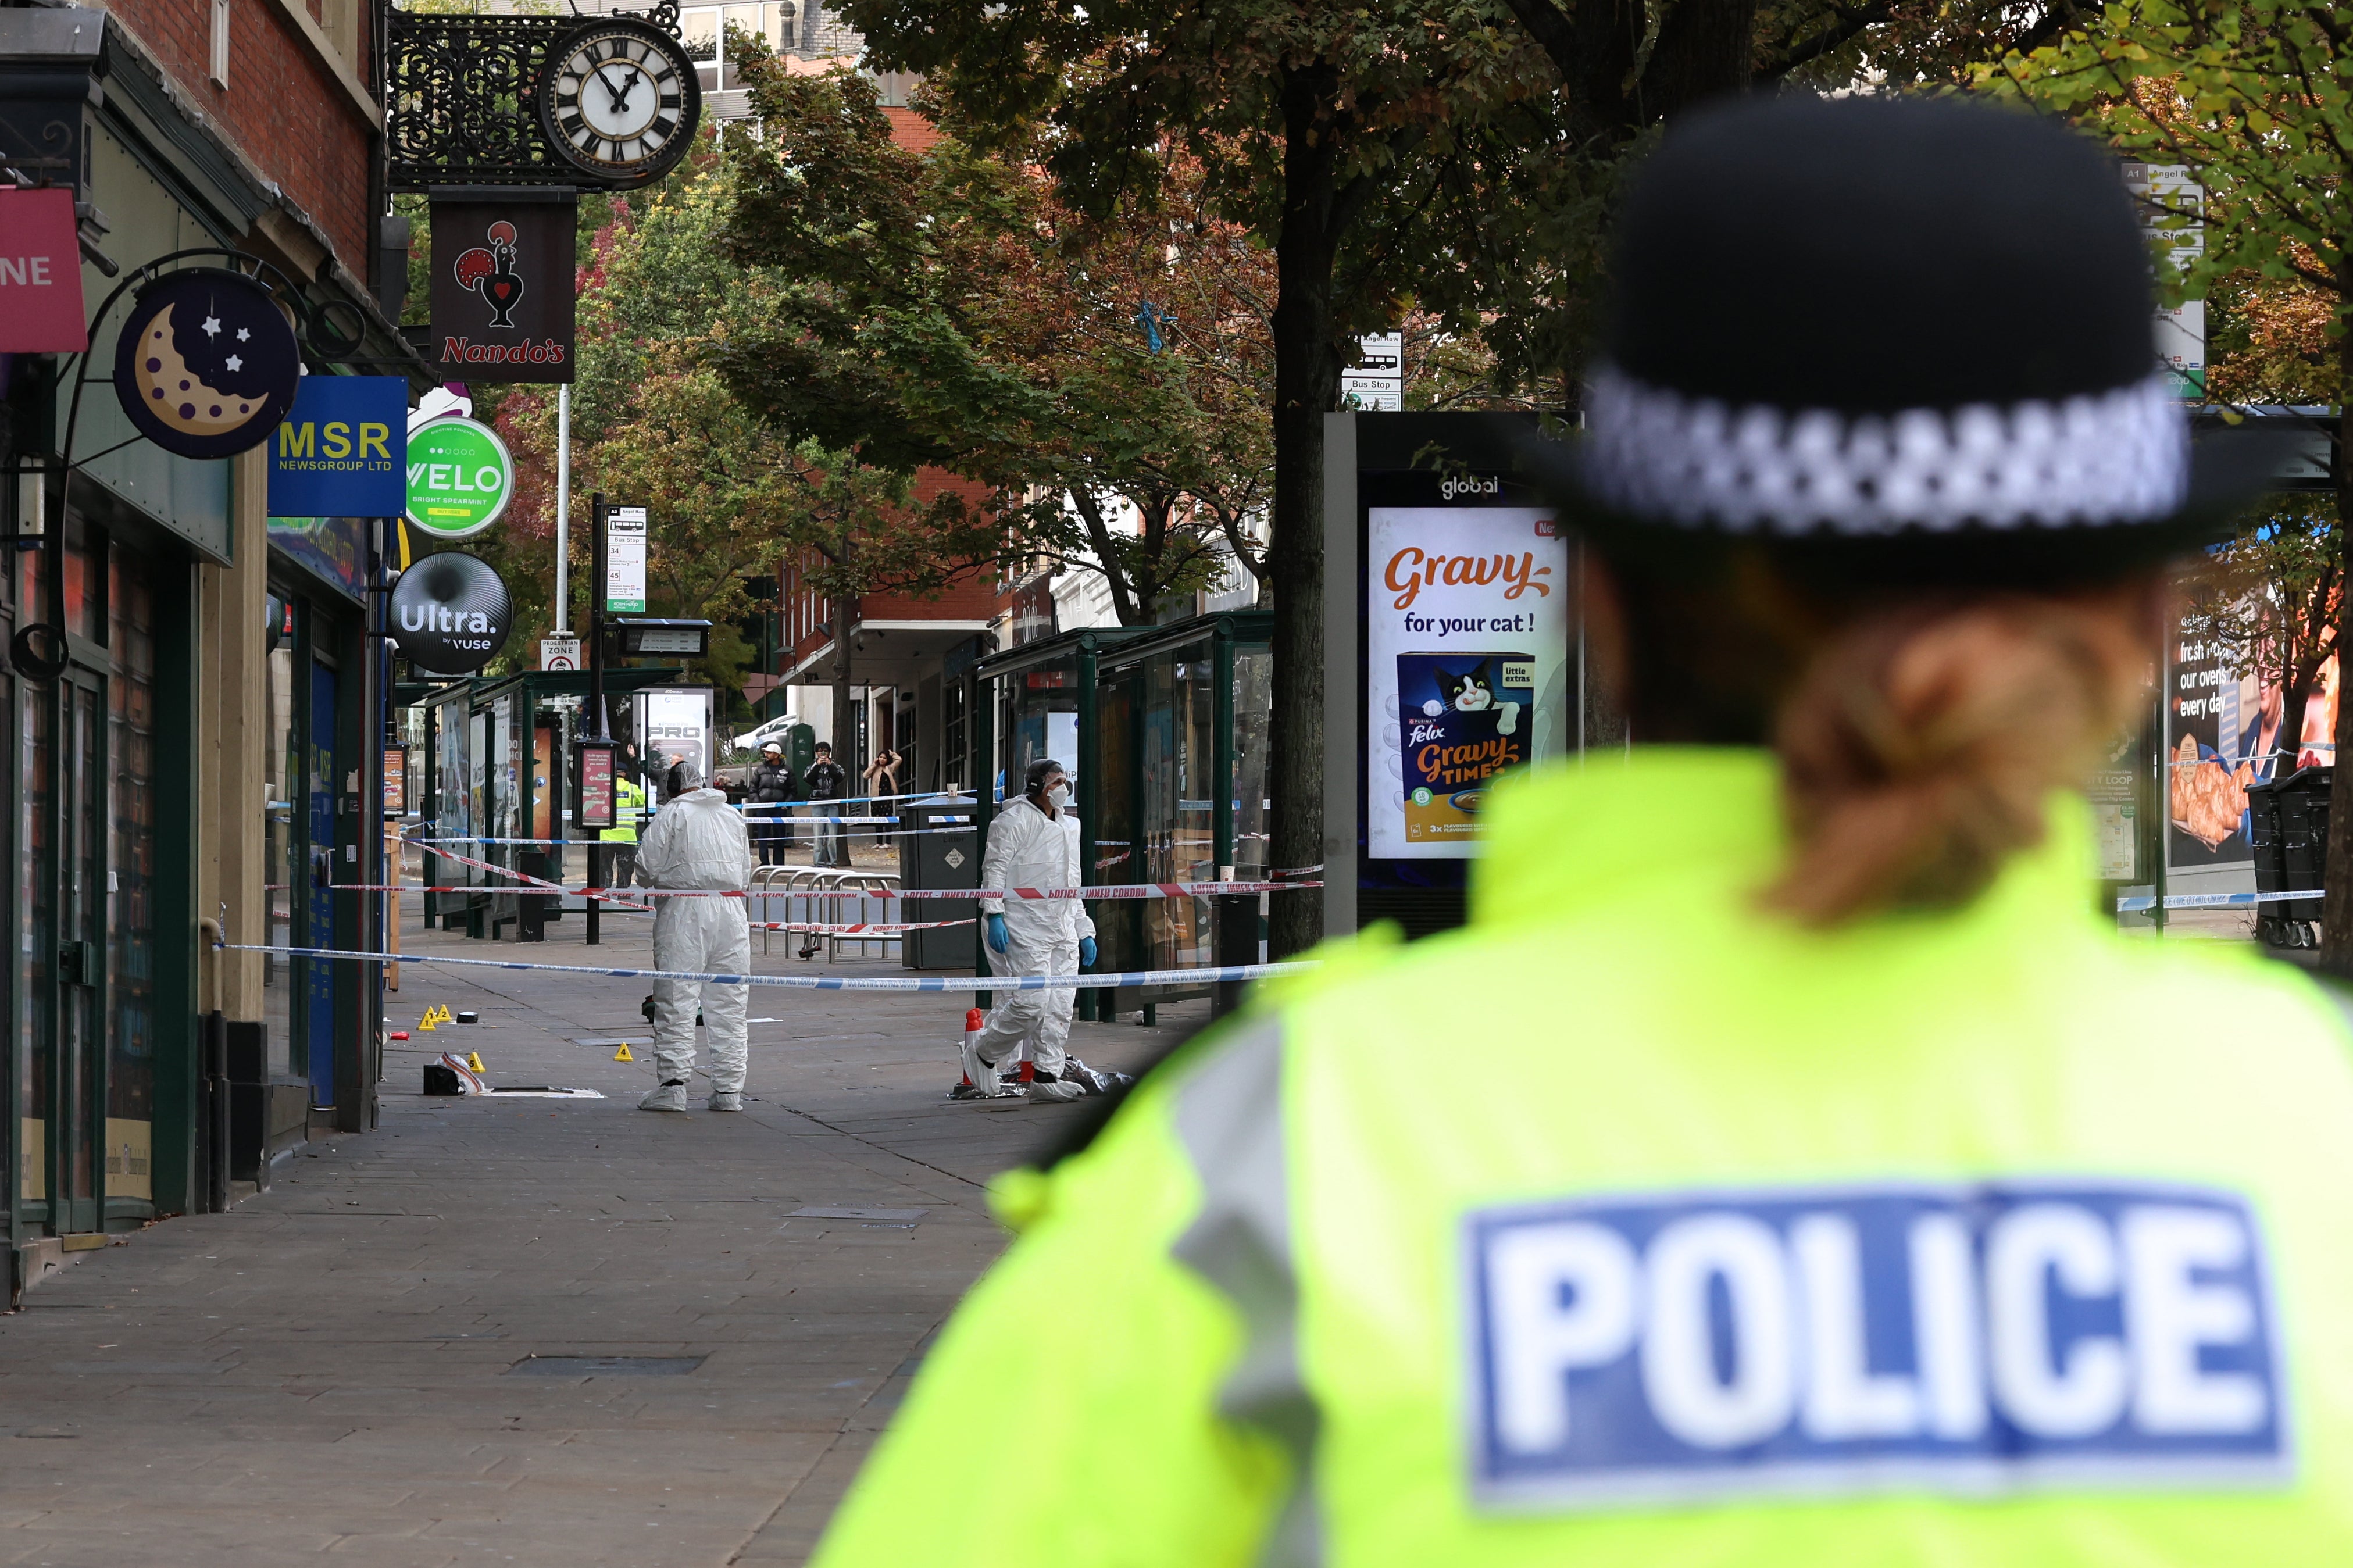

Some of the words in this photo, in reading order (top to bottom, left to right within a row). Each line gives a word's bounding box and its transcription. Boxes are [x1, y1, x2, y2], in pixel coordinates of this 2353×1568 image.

[0, 256, 52, 285] NE
[440, 337, 564, 363] Nando's
[1372, 380, 1390, 390] Stop
[279, 422, 391, 458] MSR
[431, 427, 452, 435] NICOTINE
[454, 427, 476, 437] POUCHES
[279, 460, 363, 470] NEWSGROUP
[368, 461, 391, 471] LTD
[406, 463, 502, 492] VELO
[1441, 476, 1498, 500] global
[1539, 523, 1558, 534] Ne
[1384, 547, 1551, 610] Gravy
[401, 604, 496, 634] Ultra.
[1404, 612, 1436, 632] for
[1438, 617, 1486, 637] your
[2181, 640, 2204, 663] fresh
[1505, 675, 1531, 683] extras
[1506, 667, 1526, 675] little
[2180, 672, 2197, 690] our
[2200, 668, 2227, 687] ovens
[2180, 697, 2207, 720] every
[2209, 692, 2226, 717] day
[648, 727, 700, 738] PRO
[1408, 724, 1445, 748] felix
[1417, 737, 1519, 783] Gravy
[2106, 776, 2133, 784] LOOP
[1430, 824, 1442, 833] 3x
[1484, 1201, 2269, 1453] POLICE
